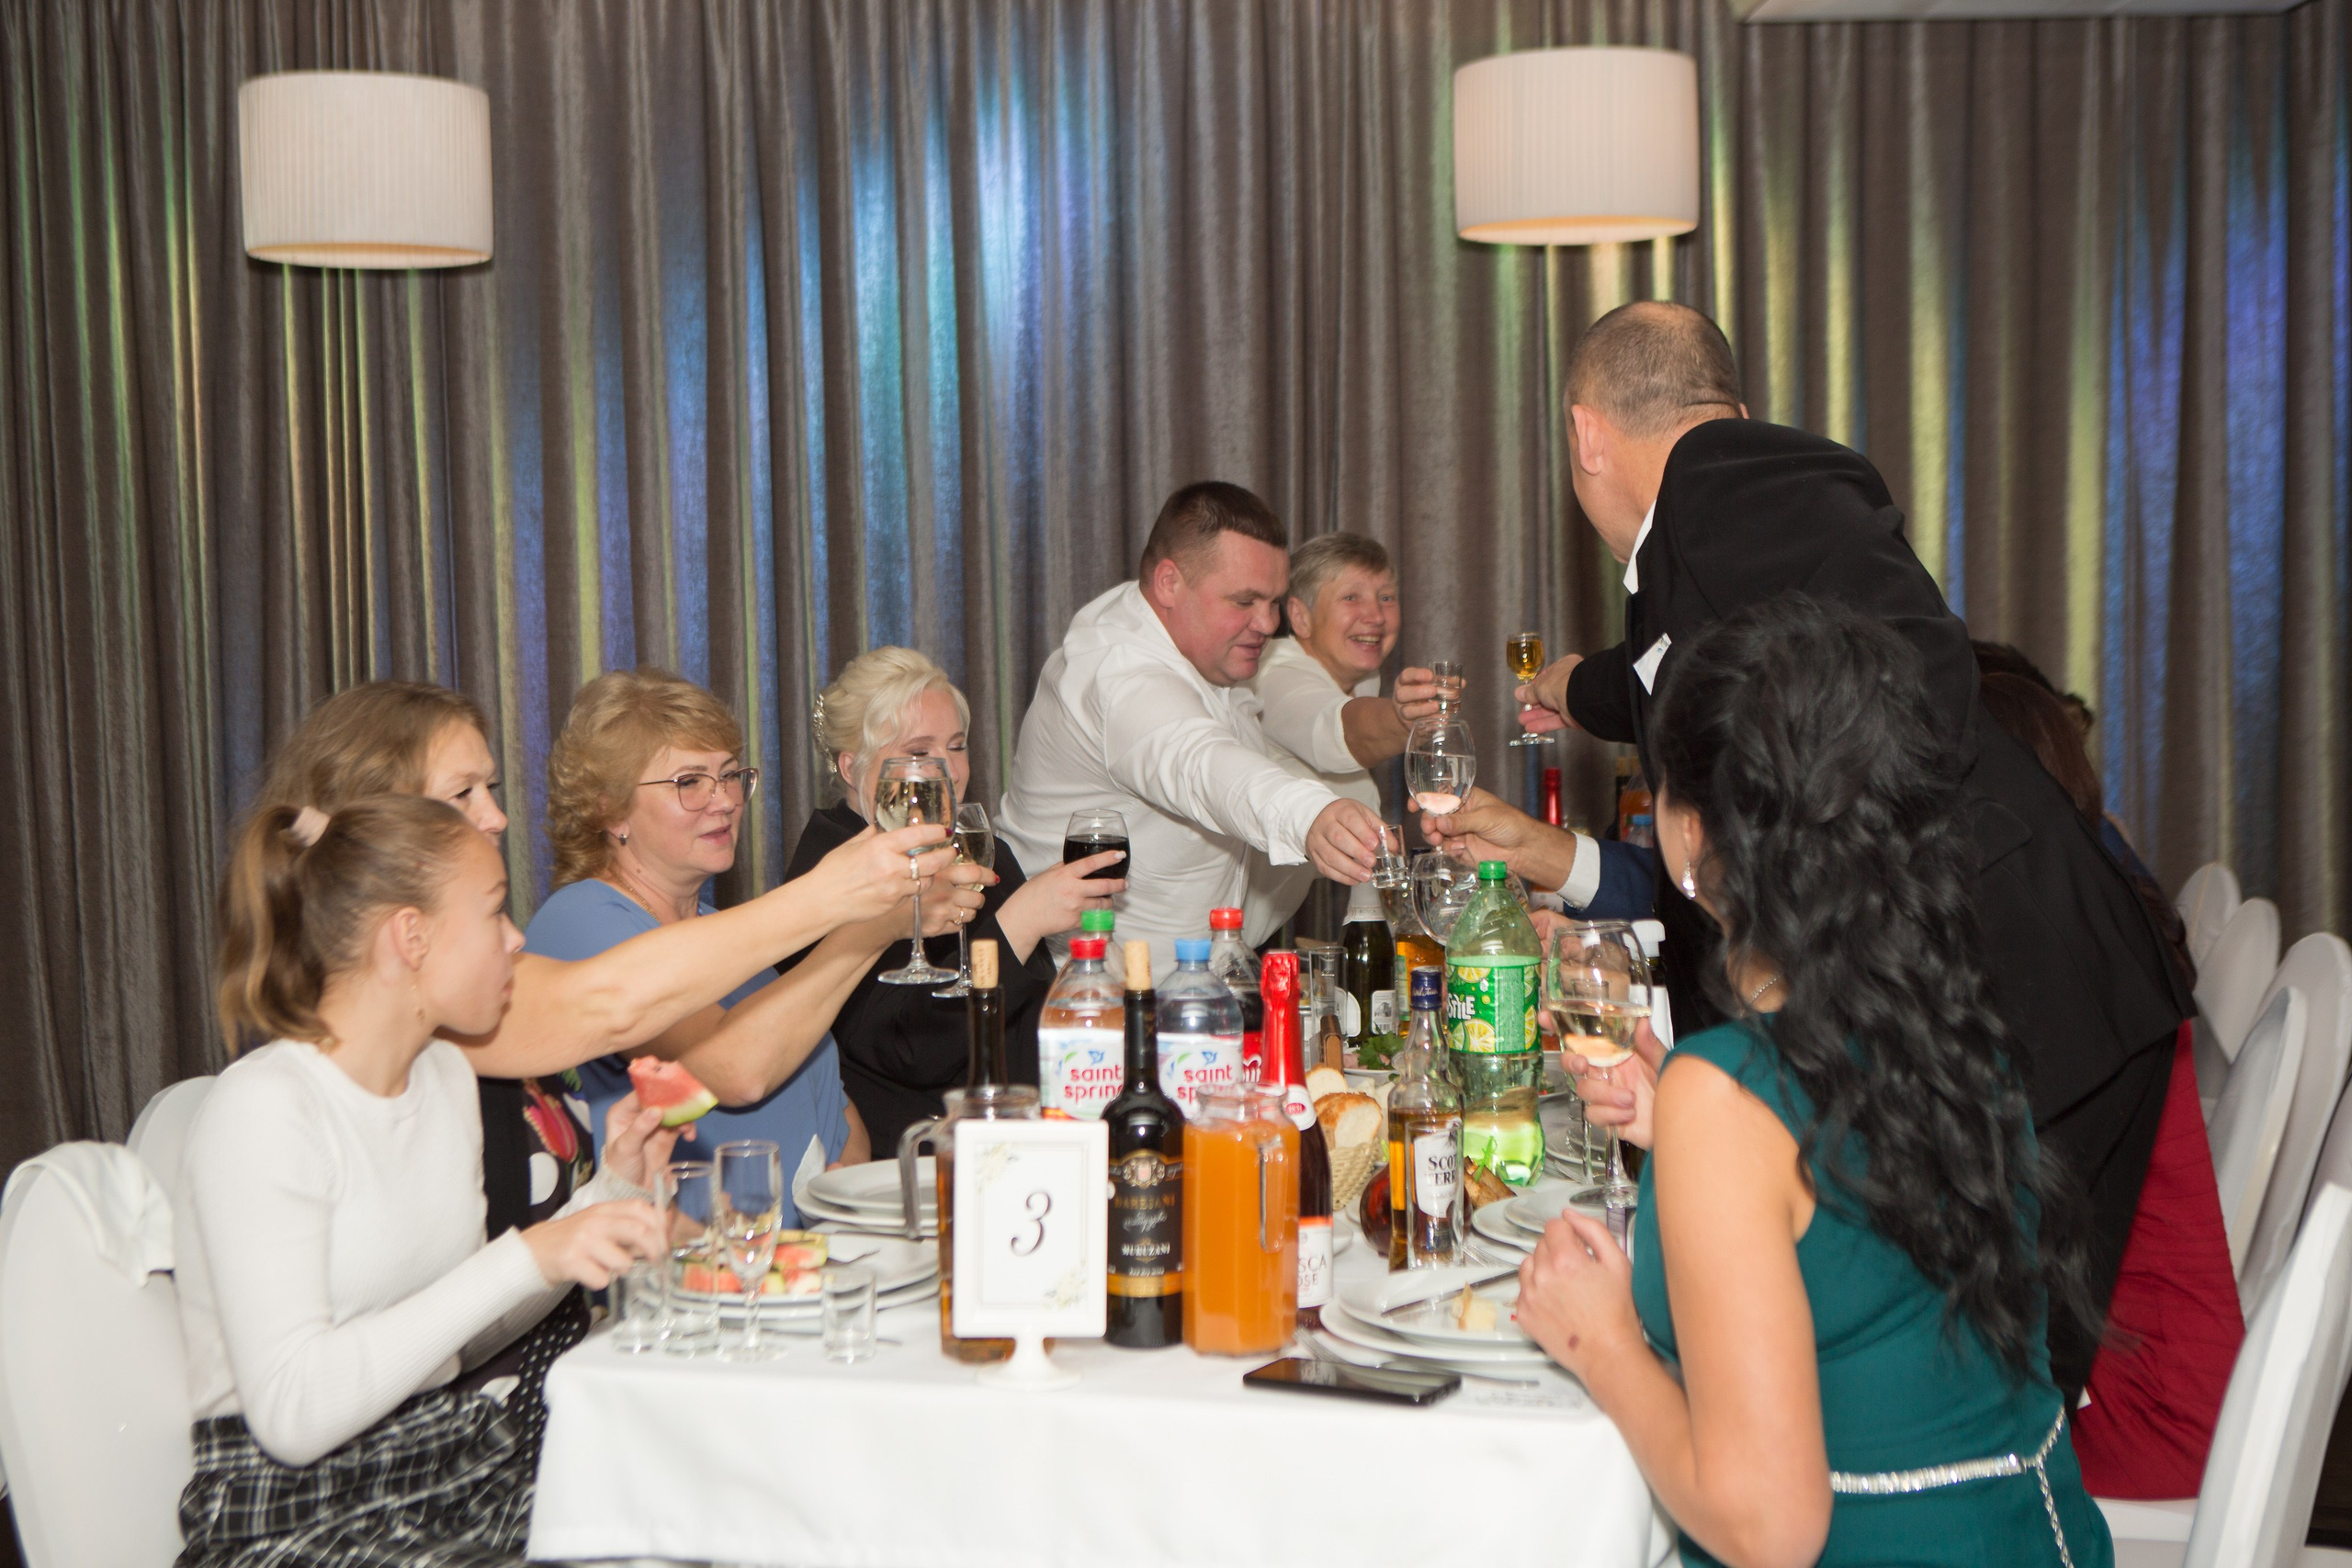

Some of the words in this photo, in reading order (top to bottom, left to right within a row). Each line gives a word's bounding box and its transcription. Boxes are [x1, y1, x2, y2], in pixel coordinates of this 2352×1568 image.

[1070, 1064, 1123, 1082] saint
[1184, 1064, 1232, 1082] saint
[1011, 1190, 1052, 1257] 3
